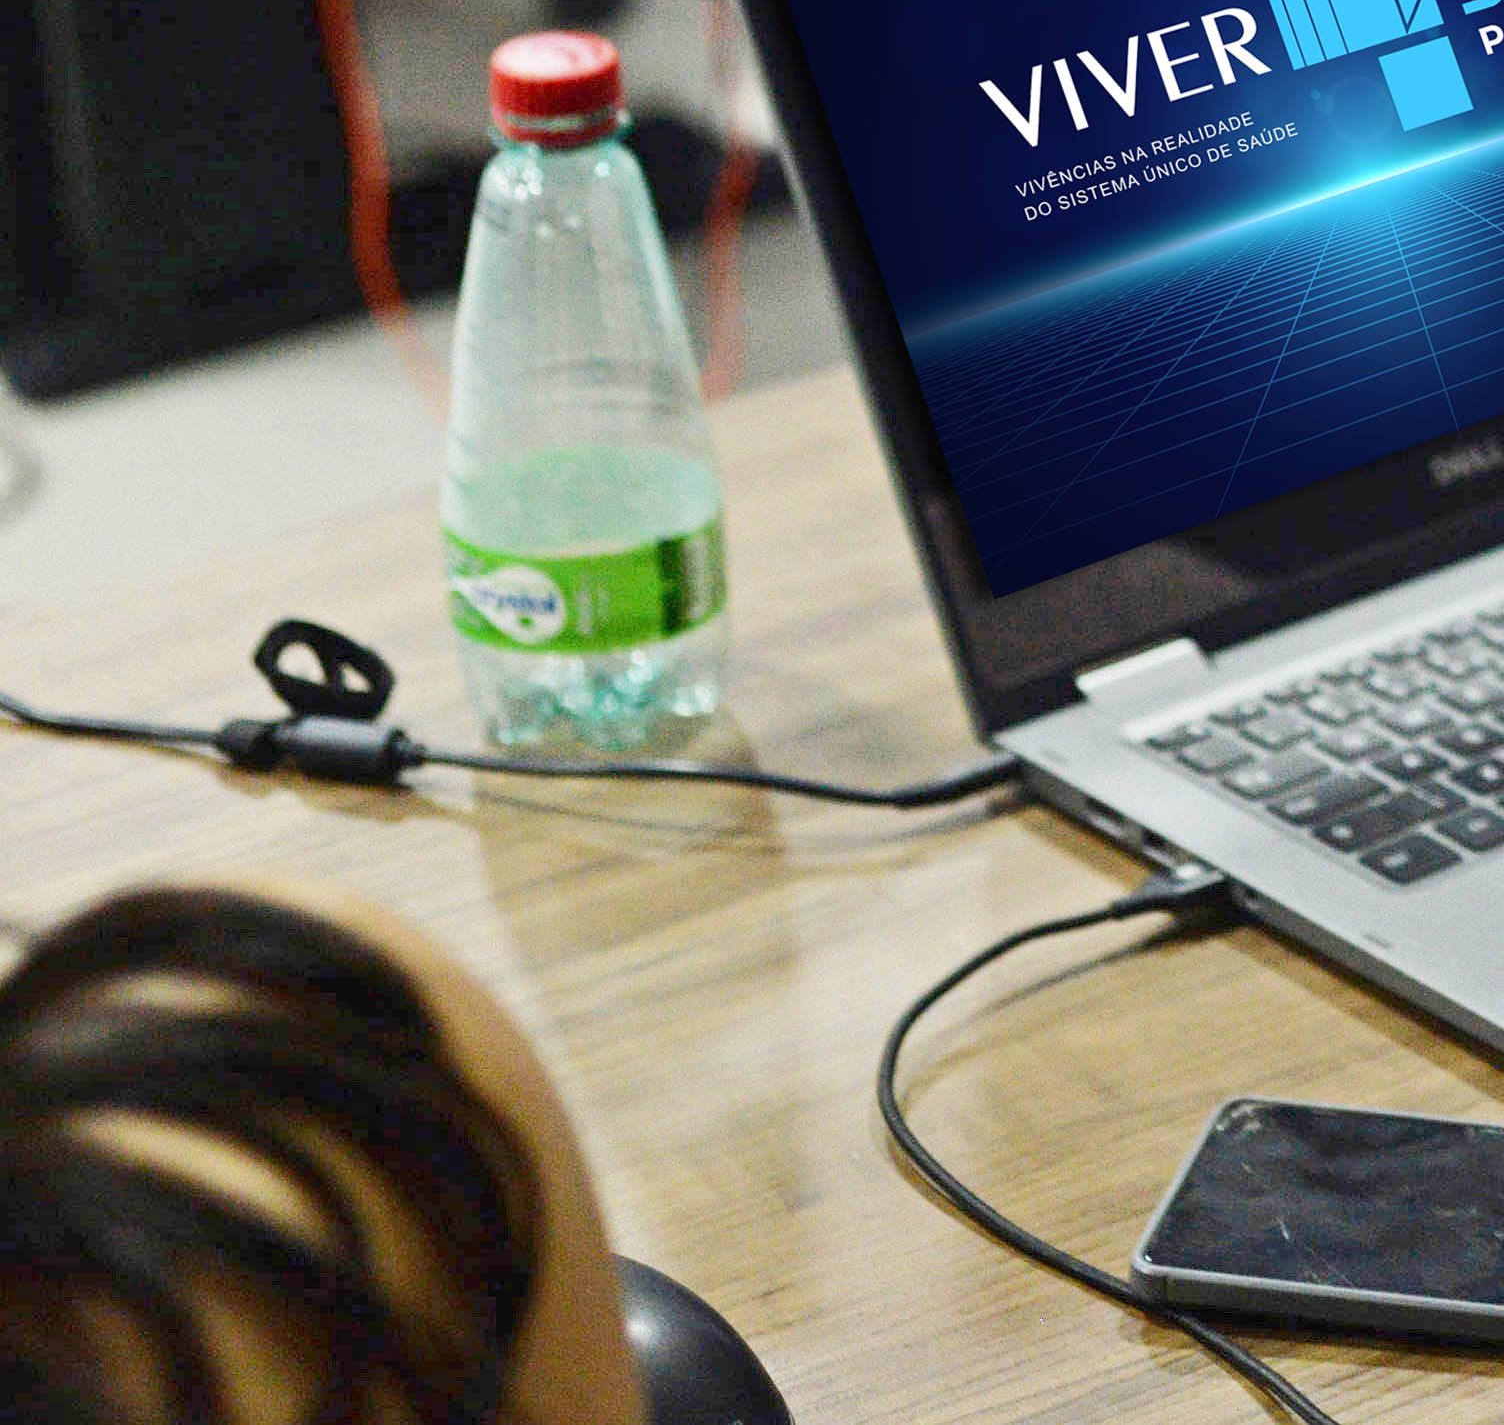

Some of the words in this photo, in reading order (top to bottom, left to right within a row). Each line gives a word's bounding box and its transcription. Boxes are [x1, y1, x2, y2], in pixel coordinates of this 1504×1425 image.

[978, 7, 1271, 148] VIVER
[1015, 154, 1117, 198] VIVÊNCIAS
[1121, 146, 1149, 167] NA
[1151, 111, 1254, 156] REALIDADE
[1023, 200, 1053, 222] DO
[1057, 175, 1140, 211] SISTEMA
[1143, 153, 1202, 183] ÚNICO
[1207, 142, 1233, 164] DE
[1237, 122, 1299, 154] SAÚDE
